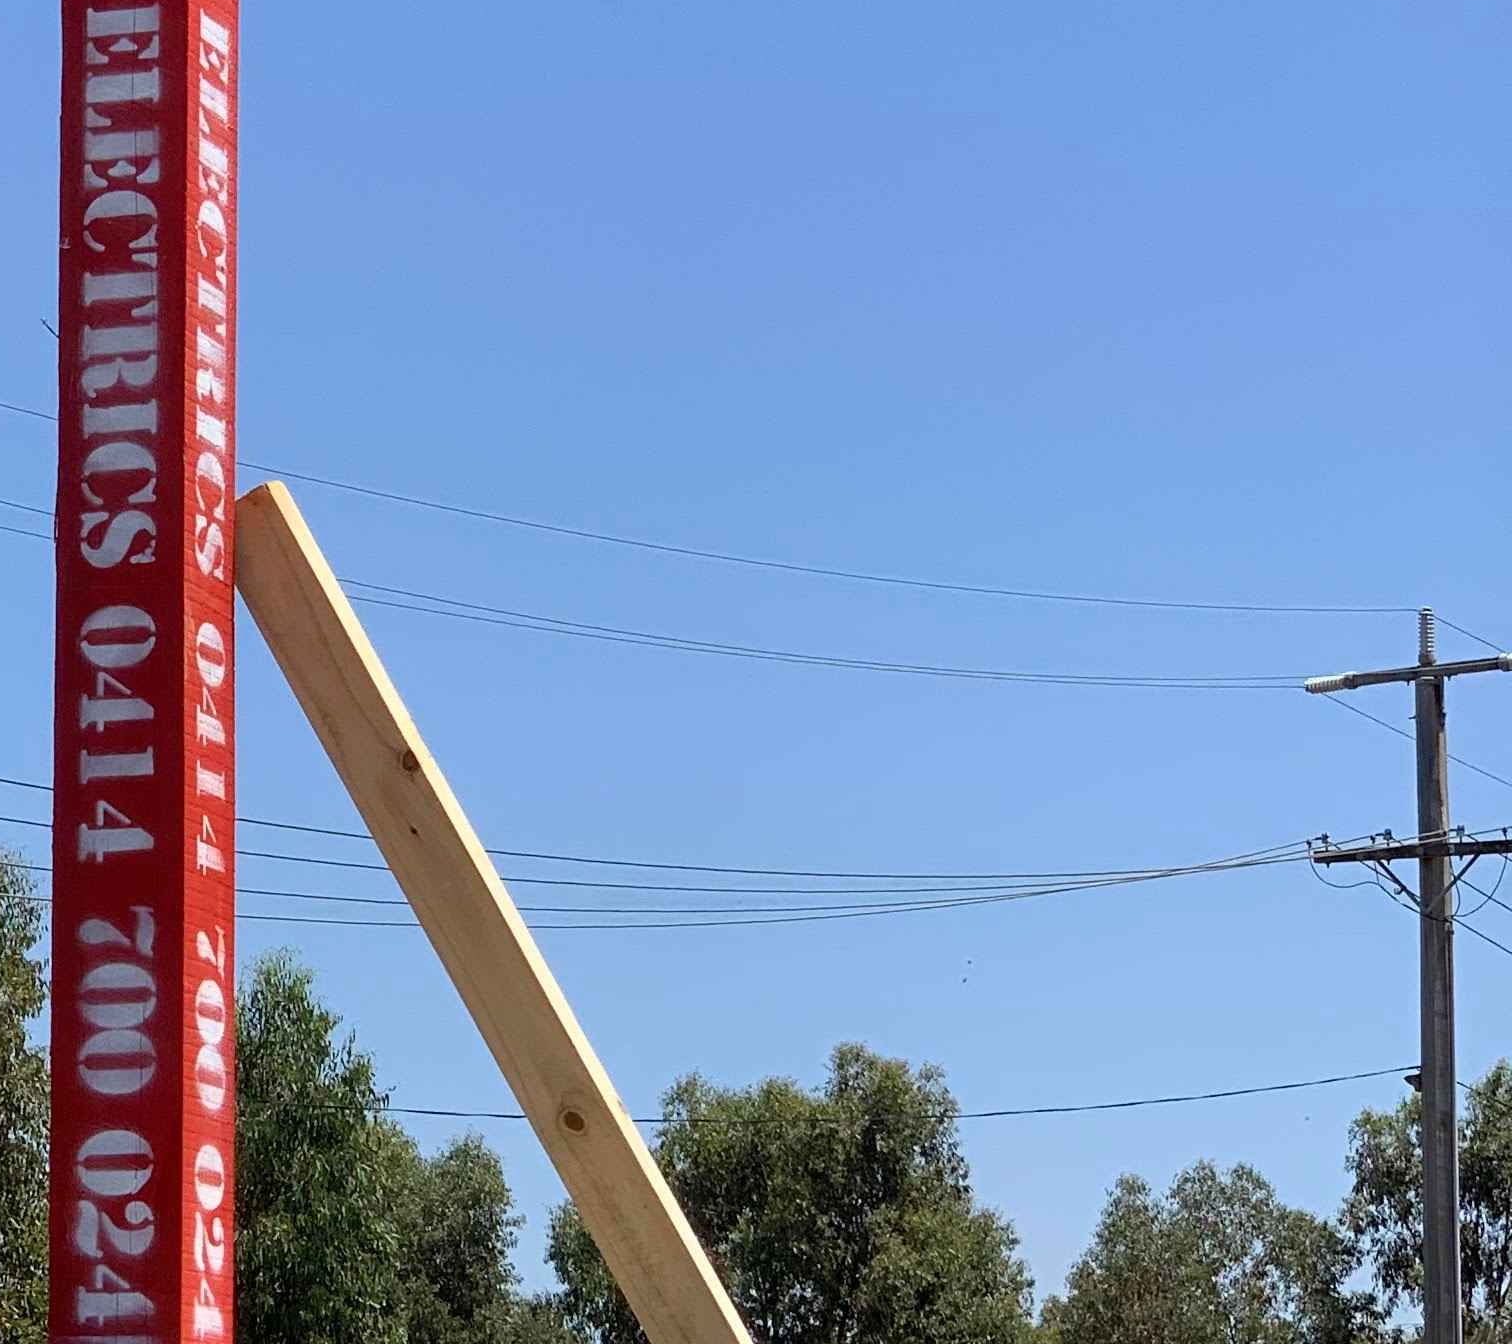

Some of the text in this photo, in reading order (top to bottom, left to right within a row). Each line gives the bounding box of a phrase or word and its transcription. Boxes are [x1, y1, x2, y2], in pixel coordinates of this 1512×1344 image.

[80, 3, 160, 568] ELECTRICS
[194, 8, 229, 581] ELECTRICS
[78, 605, 156, 864] 0414
[195, 622, 226, 876] 0414
[78, 906, 157, 1095] 700
[195, 925, 227, 1110] 700
[74, 1130, 155, 1326] 024
[193, 1144, 224, 1341] 024
